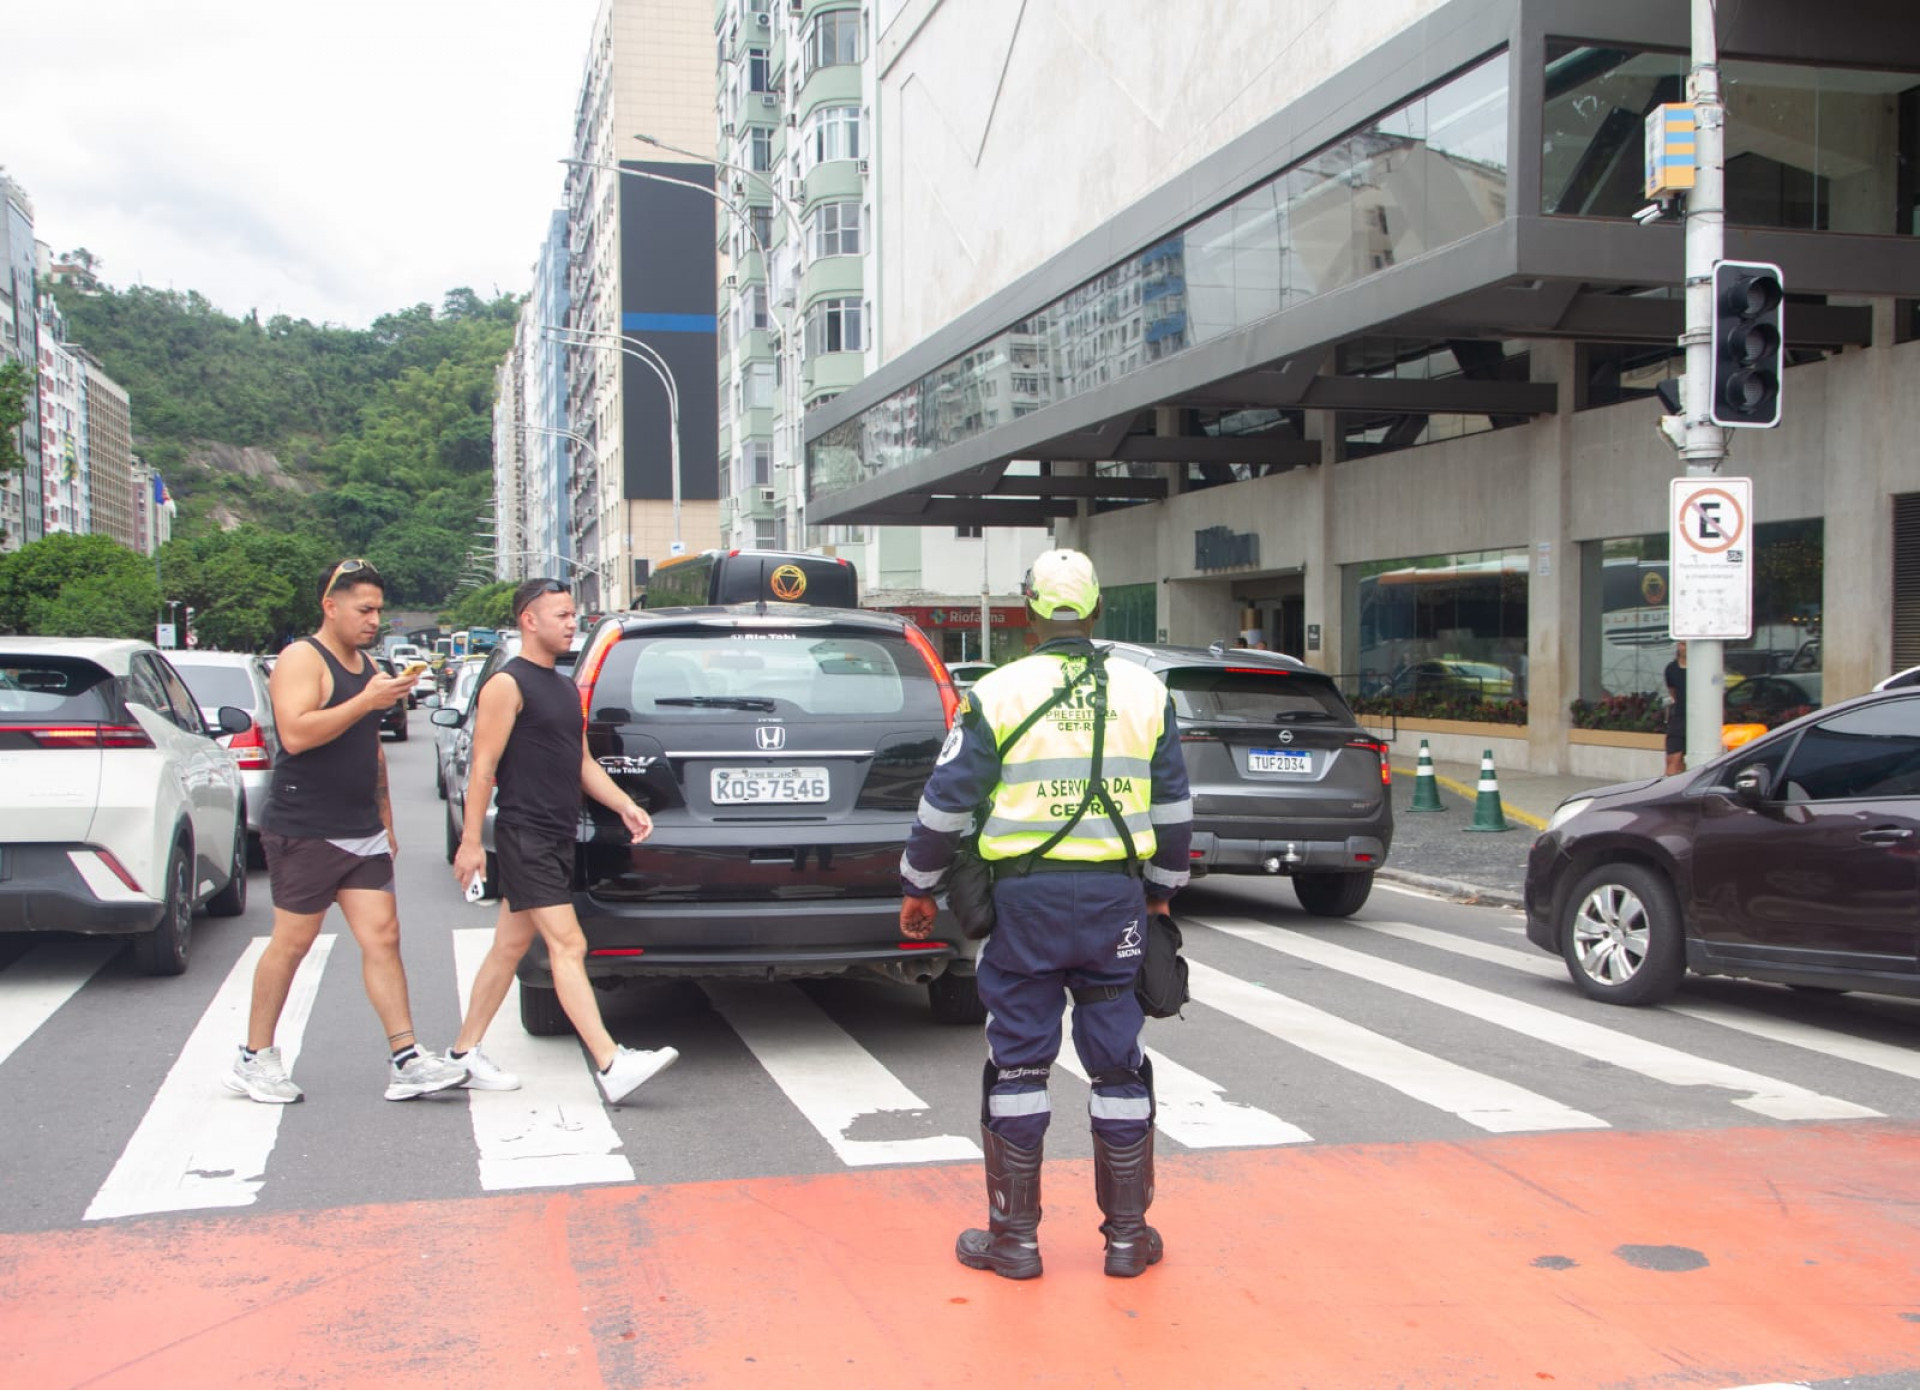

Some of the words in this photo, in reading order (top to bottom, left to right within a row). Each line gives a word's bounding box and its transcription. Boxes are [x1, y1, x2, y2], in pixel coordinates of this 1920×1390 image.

[1699, 503, 1720, 538] E
[949, 610, 1006, 624] Riofama
[1046, 709, 1118, 720] PREFEITRA
[1254, 756, 1305, 771] TUF2D34
[1037, 782, 1047, 798] A
[1051, 778, 1110, 797] SERVIO
[1113, 778, 1133, 794] DA
